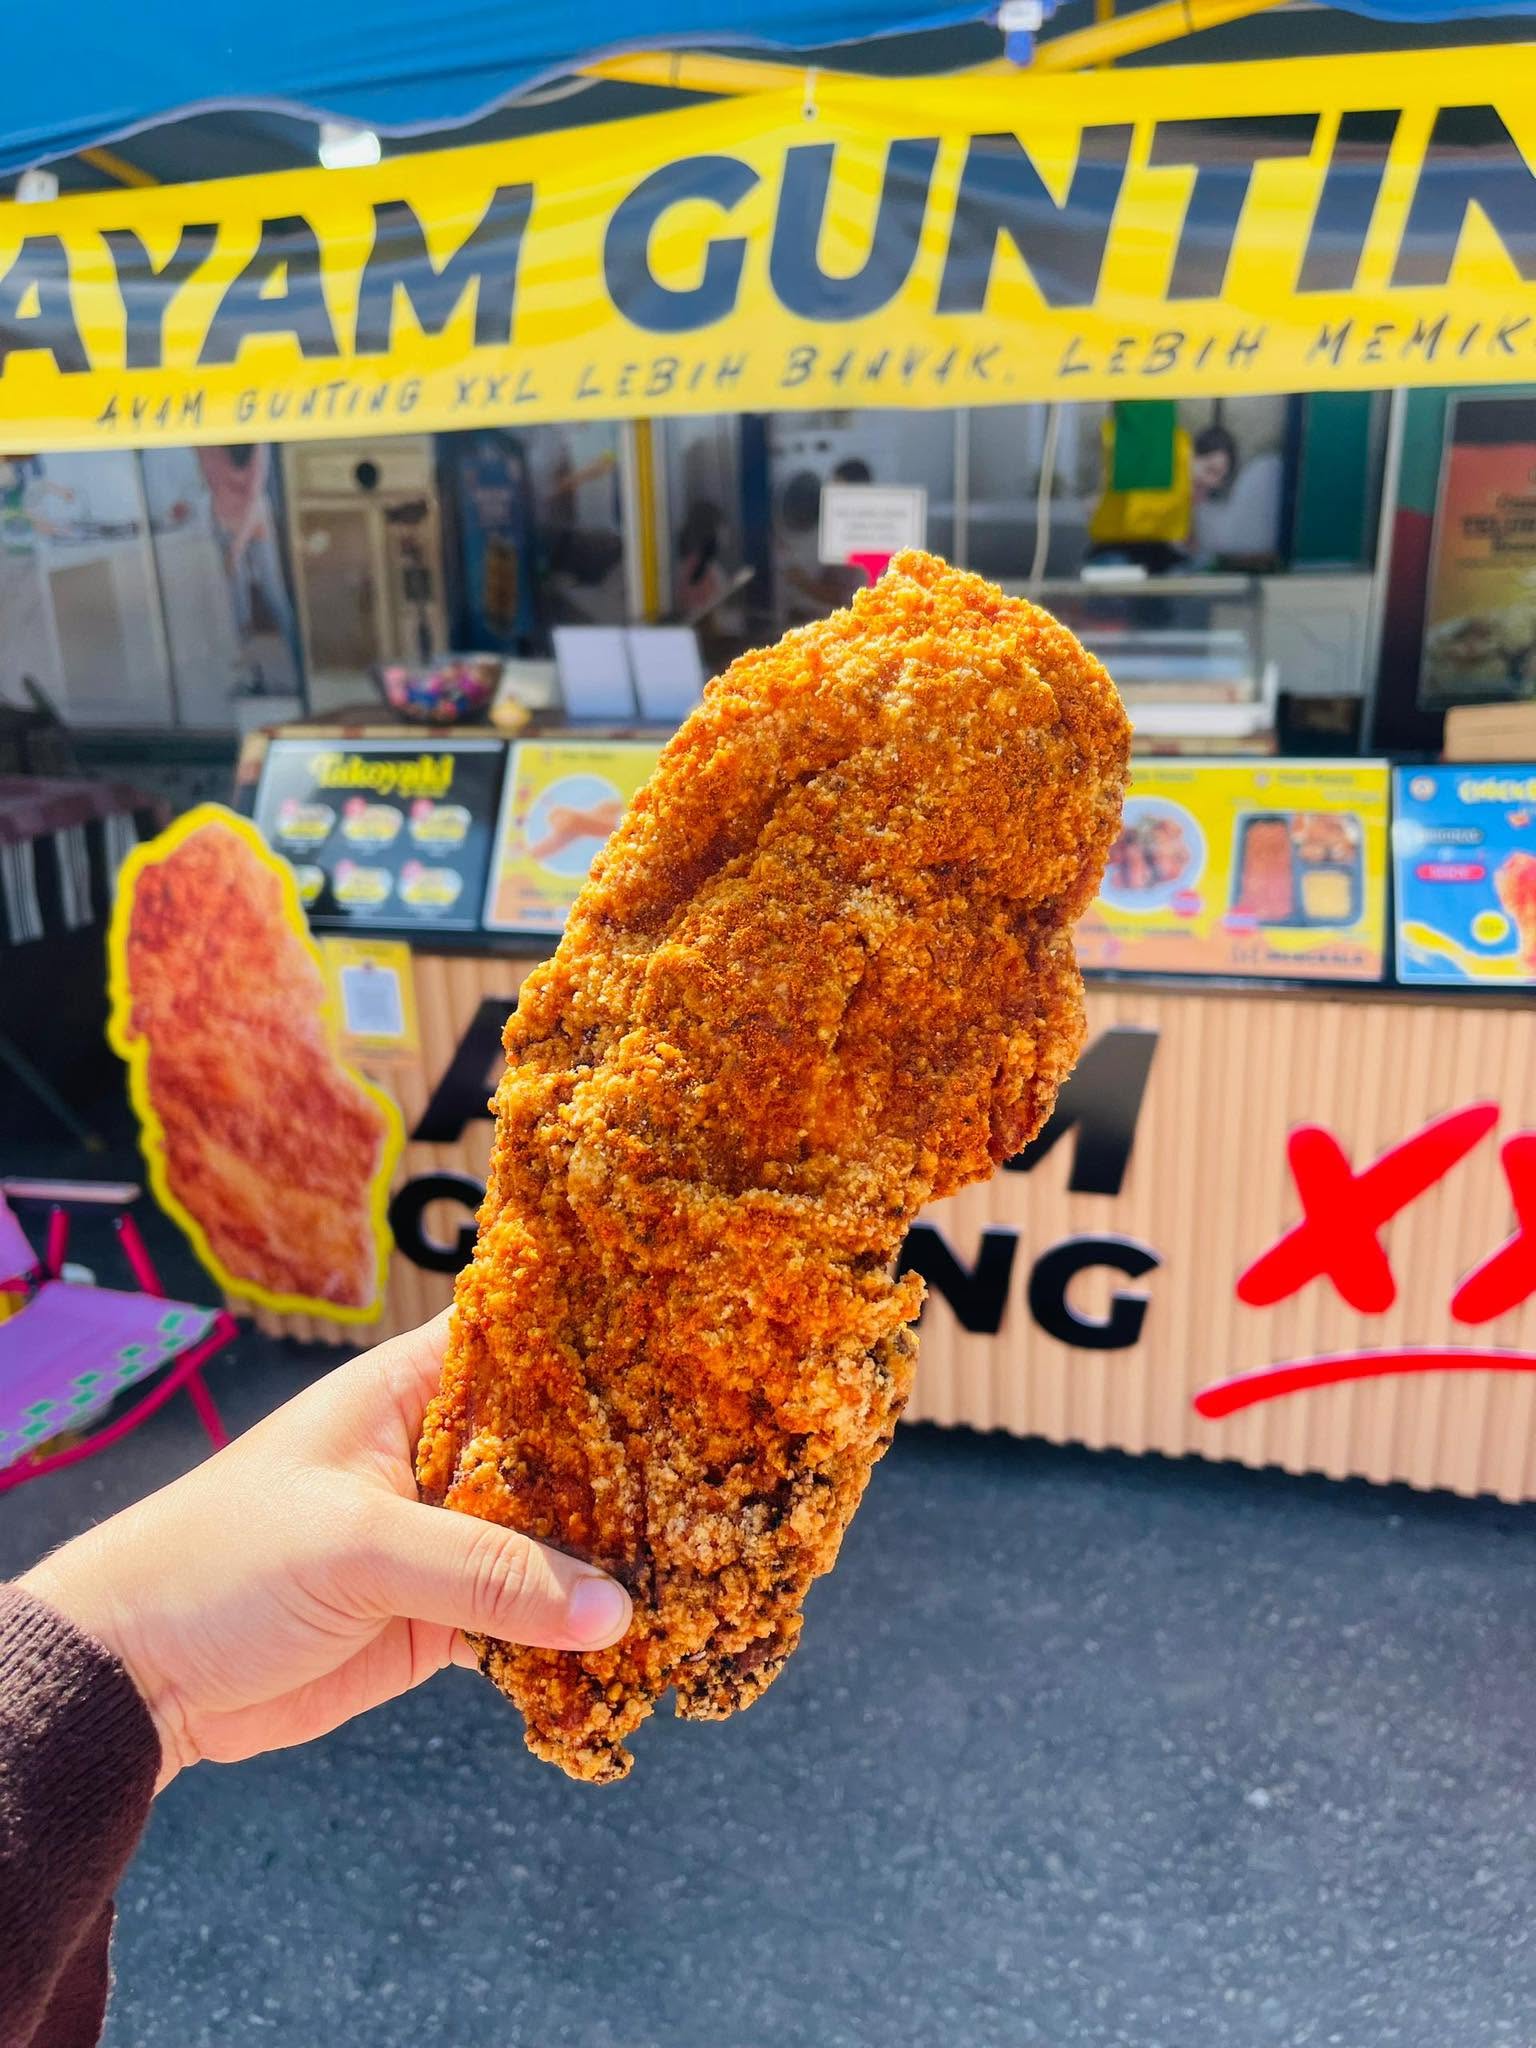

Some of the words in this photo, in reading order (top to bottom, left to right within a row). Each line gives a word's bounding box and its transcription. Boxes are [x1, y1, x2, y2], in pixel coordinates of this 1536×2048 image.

[0, 182, 535, 376] AYAM
[603, 103, 1536, 333] GUNTIN
[96, 388, 205, 432] AYAM
[234, 378, 424, 422] GUNTING
[453, 370, 541, 409] XXL
[576, 353, 748, 400] LEBIH
[1058, 325, 1267, 377] LEBIH
[1306, 313, 1536, 366] MEMIK
